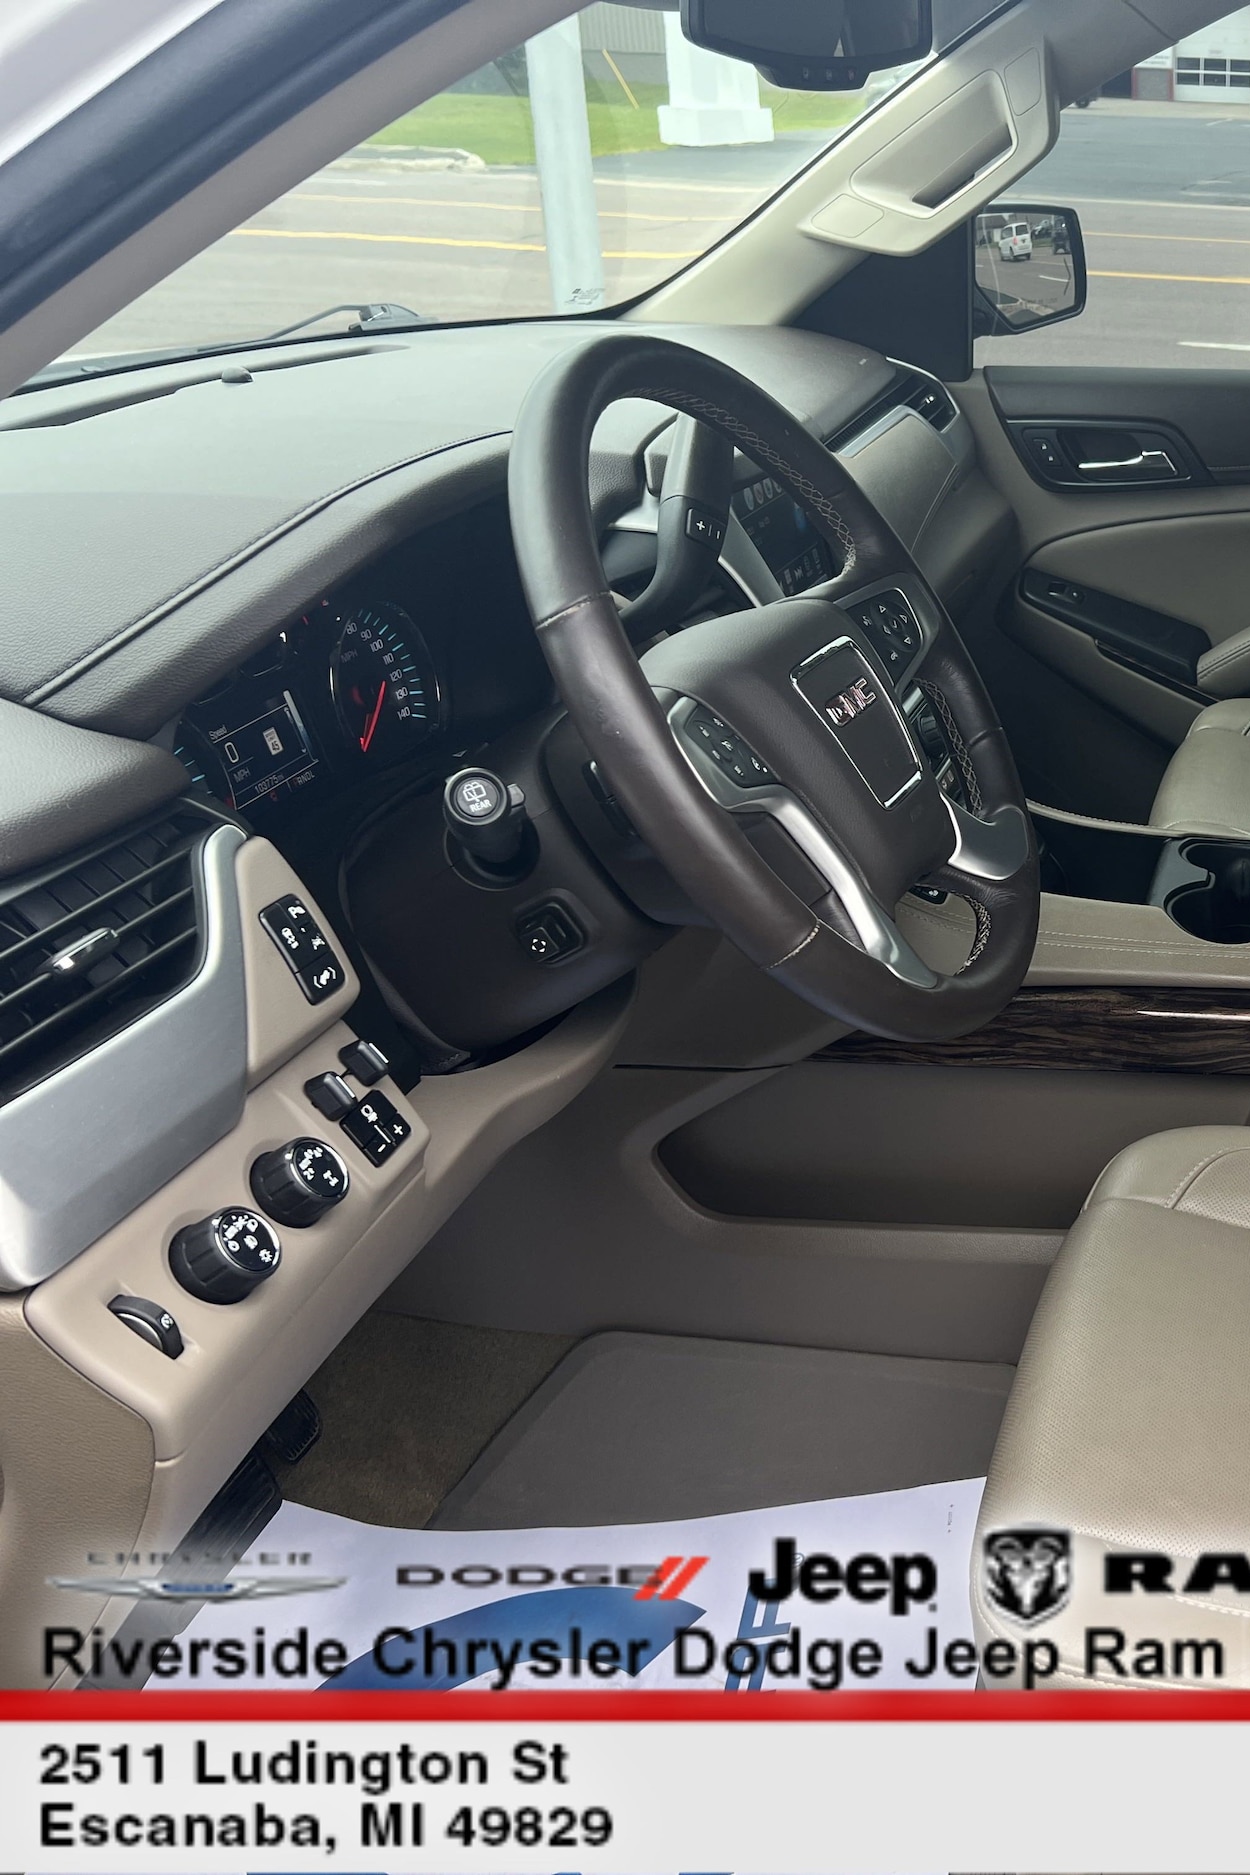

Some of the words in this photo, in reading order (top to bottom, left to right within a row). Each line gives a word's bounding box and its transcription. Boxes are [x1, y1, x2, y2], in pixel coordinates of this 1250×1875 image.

[346, 622, 358, 635] 80
[360, 628, 372, 641] 90
[369, 638, 384, 653] 100
[340, 649, 358, 663] MPH
[382, 652, 395, 665] 110
[389, 668, 403, 682] 120
[395, 686, 408, 700] 130
[825, 677, 877, 728] GMC
[397, 706, 411, 720] 140
[208, 724, 228, 741] Speed
[224, 741, 240, 764] 0
[233, 768, 251, 783] MPH
[469, 799, 493, 813] REAR
